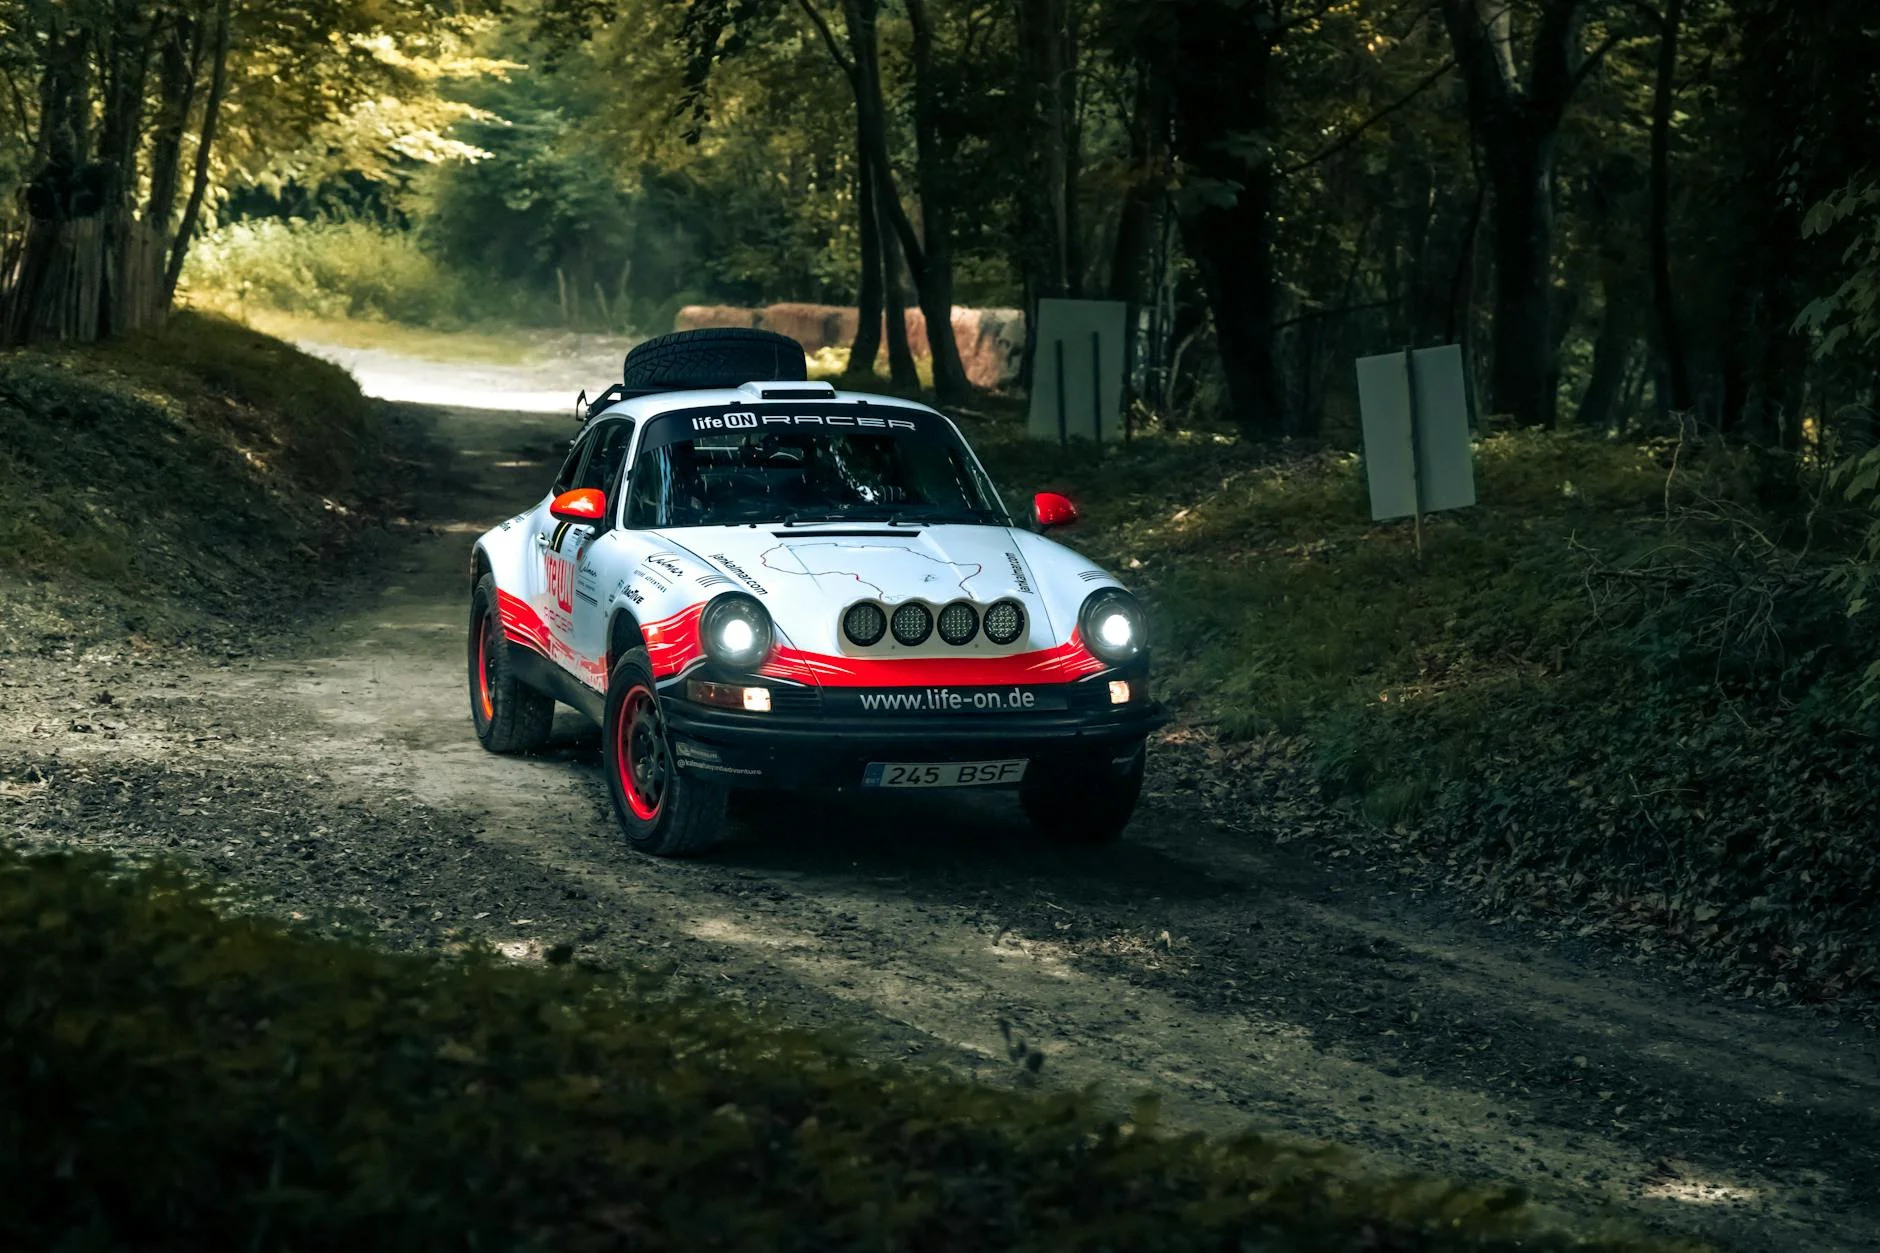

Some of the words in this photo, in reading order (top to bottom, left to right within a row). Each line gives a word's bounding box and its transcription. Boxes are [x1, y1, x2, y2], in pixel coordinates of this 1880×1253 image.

[762, 415, 916, 431] RACER
[860, 688, 1035, 711] www.life-on.de
[888, 767, 940, 785] 245
[957, 763, 1020, 784] BSF
